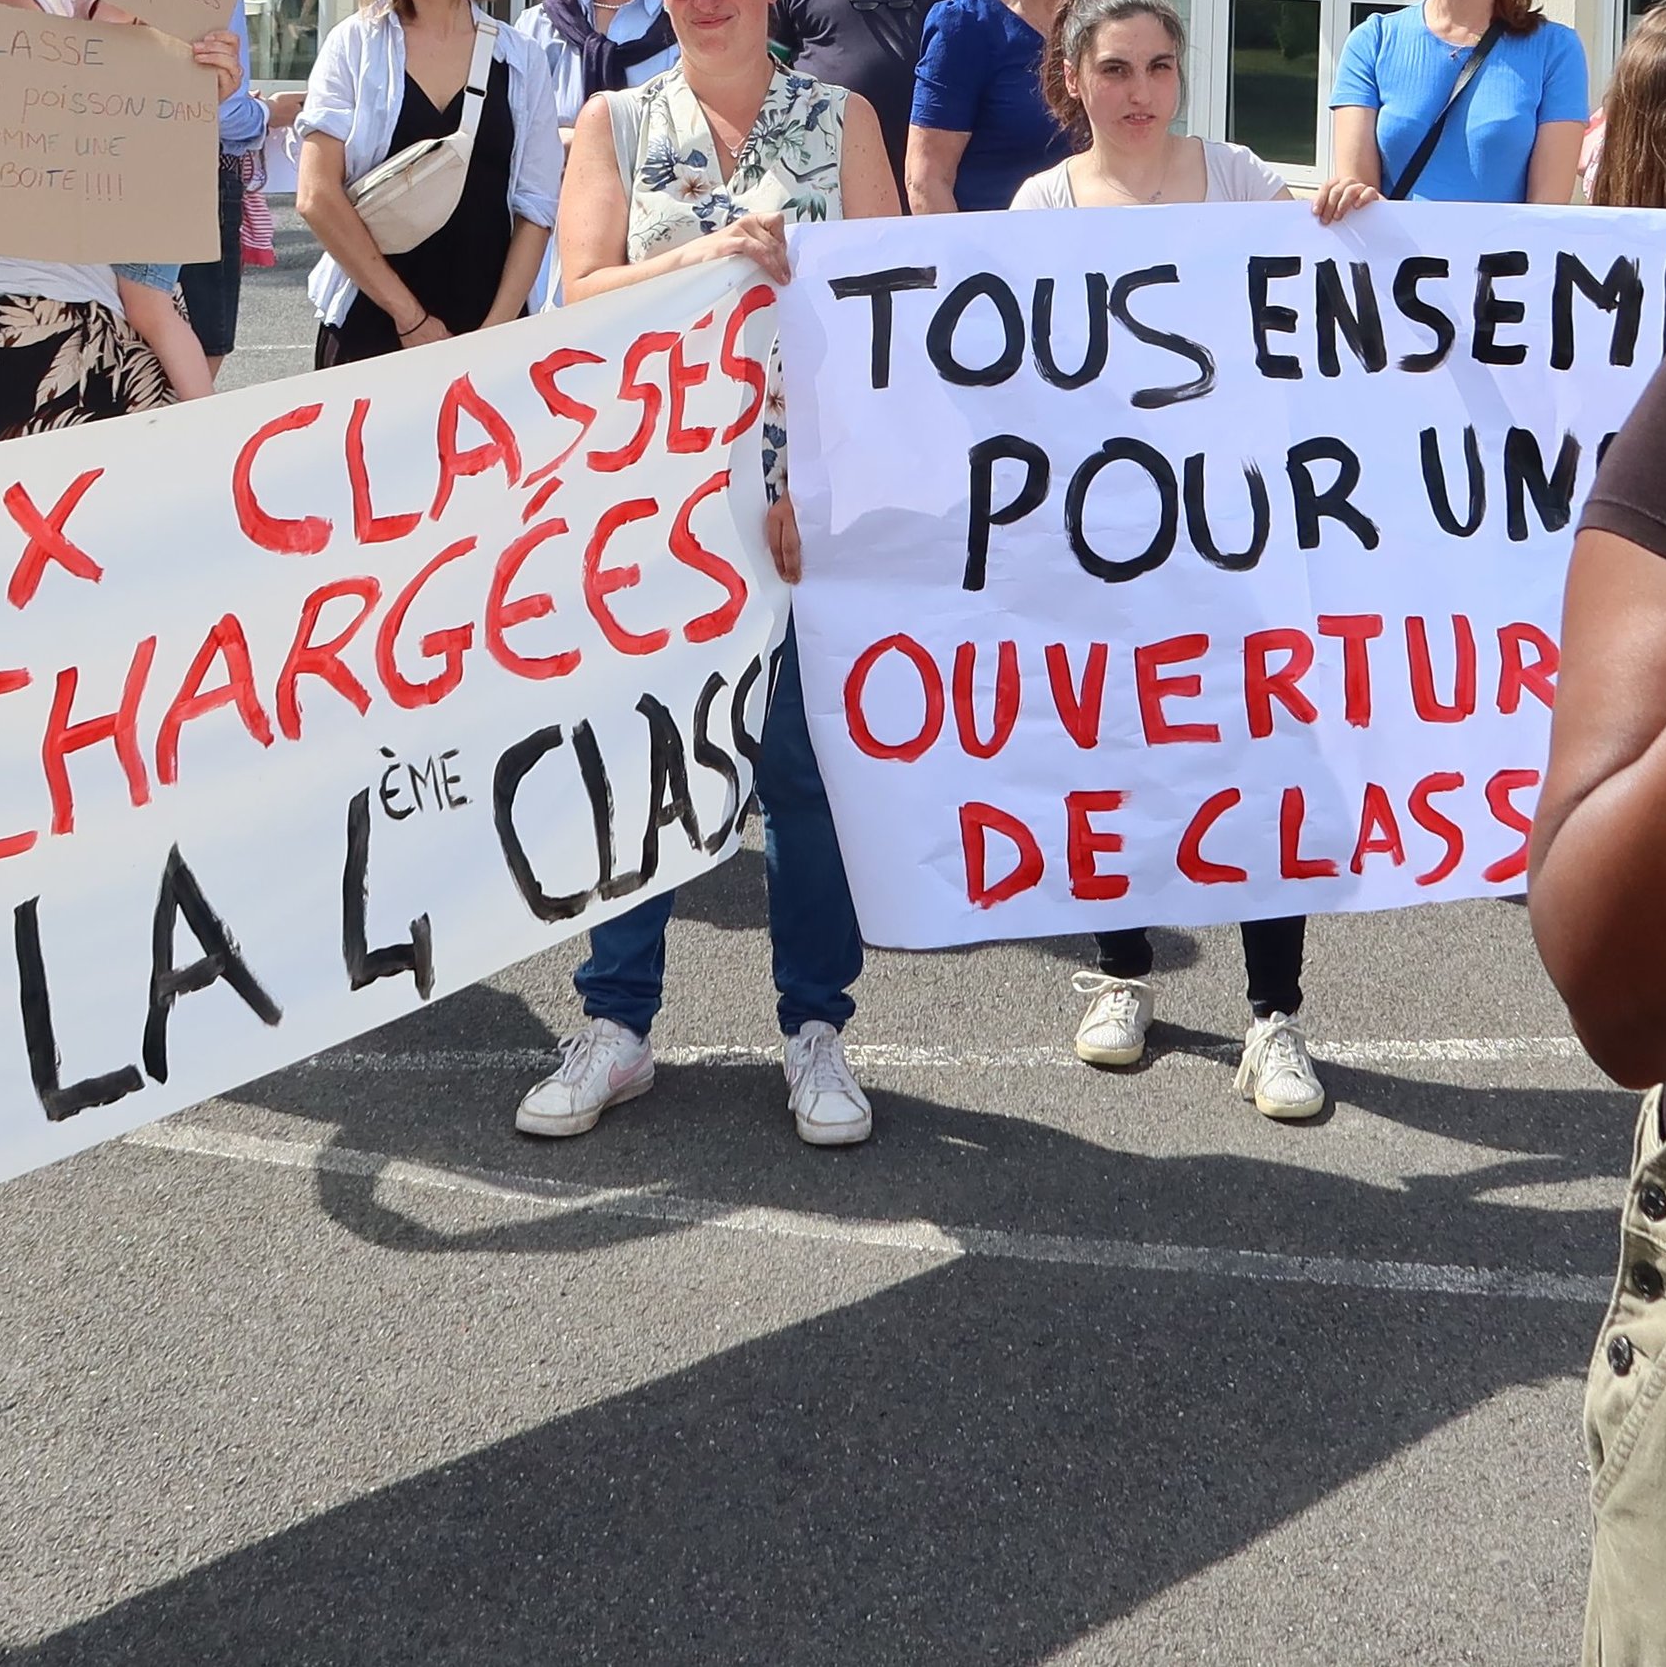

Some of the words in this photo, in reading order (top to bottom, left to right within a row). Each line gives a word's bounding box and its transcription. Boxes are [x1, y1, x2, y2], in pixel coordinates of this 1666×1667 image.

[75, 135, 127, 157] UNE
[156, 98, 216, 123] DANS
[827, 262, 1218, 410] TOUS
[231, 283, 779, 556] CLASSES
[962, 433, 1381, 593] POUR
[1419, 424, 1621, 542] UN
[842, 614, 1561, 764] OUVERTUR
[13, 840, 284, 1123] LA
[492, 642, 786, 926] CLASS
[958, 788, 1133, 911] DE
[1175, 766, 1541, 888] CLASS
